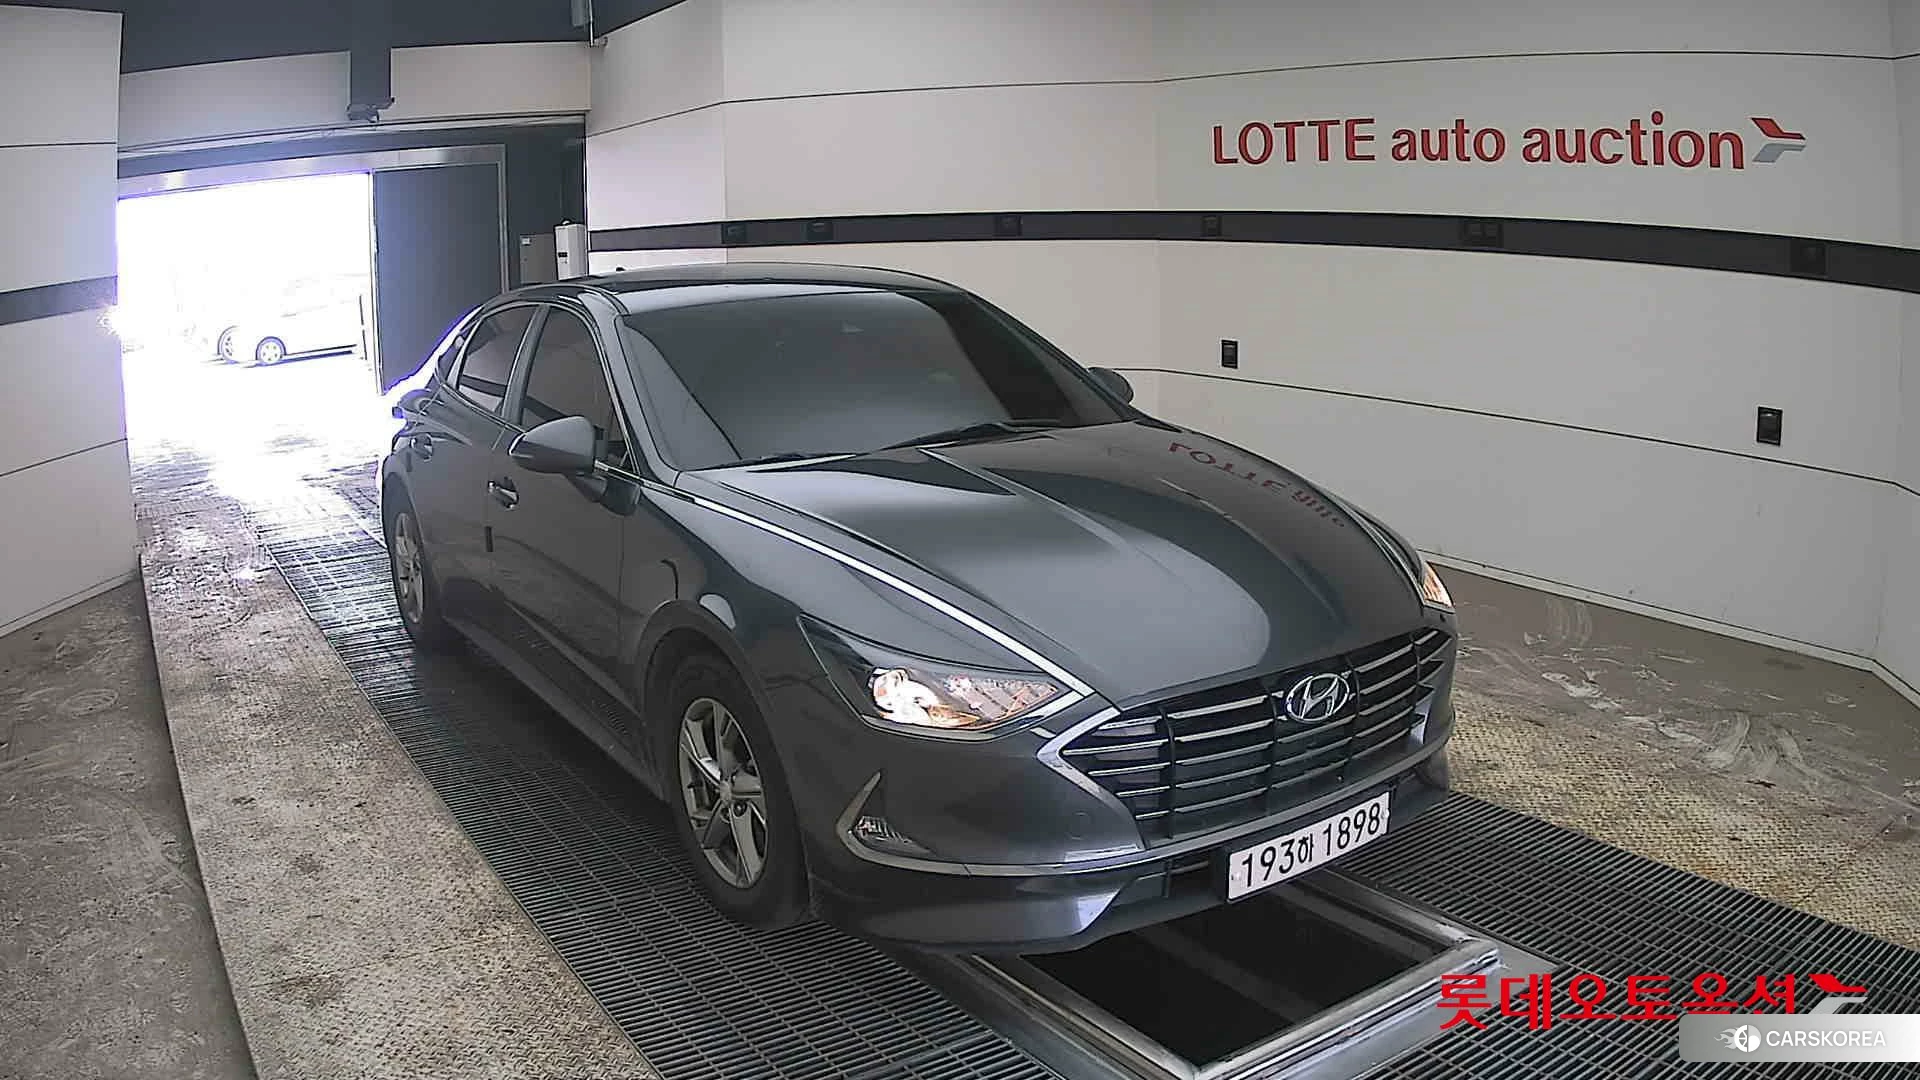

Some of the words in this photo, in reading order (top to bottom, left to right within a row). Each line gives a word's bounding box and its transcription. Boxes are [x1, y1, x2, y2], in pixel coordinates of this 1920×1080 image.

[1213, 118, 1375, 165] LOTTE
[1391, 118, 1506, 163] auto
[1522, 111, 1745, 170] auction
[1242, 833, 1314, 888] 193하
[1322, 802, 1381, 857] 1898
